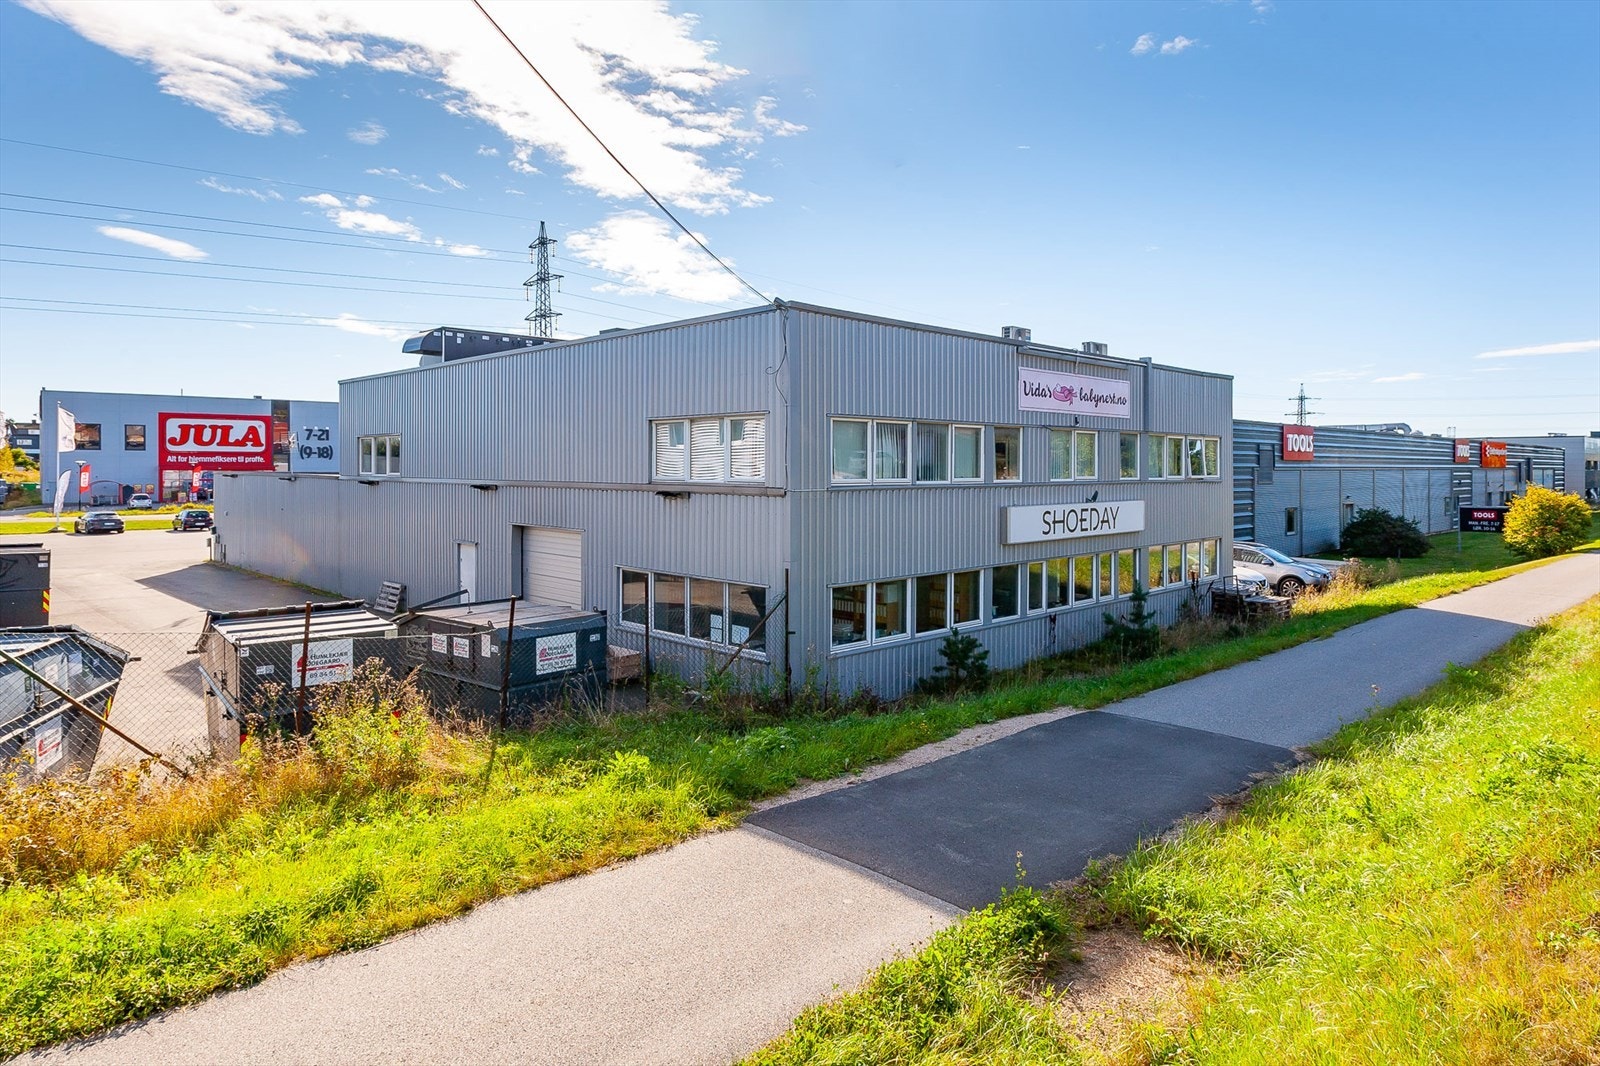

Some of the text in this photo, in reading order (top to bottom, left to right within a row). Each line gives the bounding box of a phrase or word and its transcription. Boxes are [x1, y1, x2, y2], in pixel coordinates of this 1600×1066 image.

[1023, 381, 1127, 408] Vida's babynest.no
[168, 424, 264, 447] JULA
[305, 429, 329, 441] 7-21
[1287, 434, 1314, 452] TOOLS
[300, 445, 333, 460] (9-18)
[1457, 444, 1470, 457] TOOLS
[1042, 507, 1119, 535] SHOEDAY
